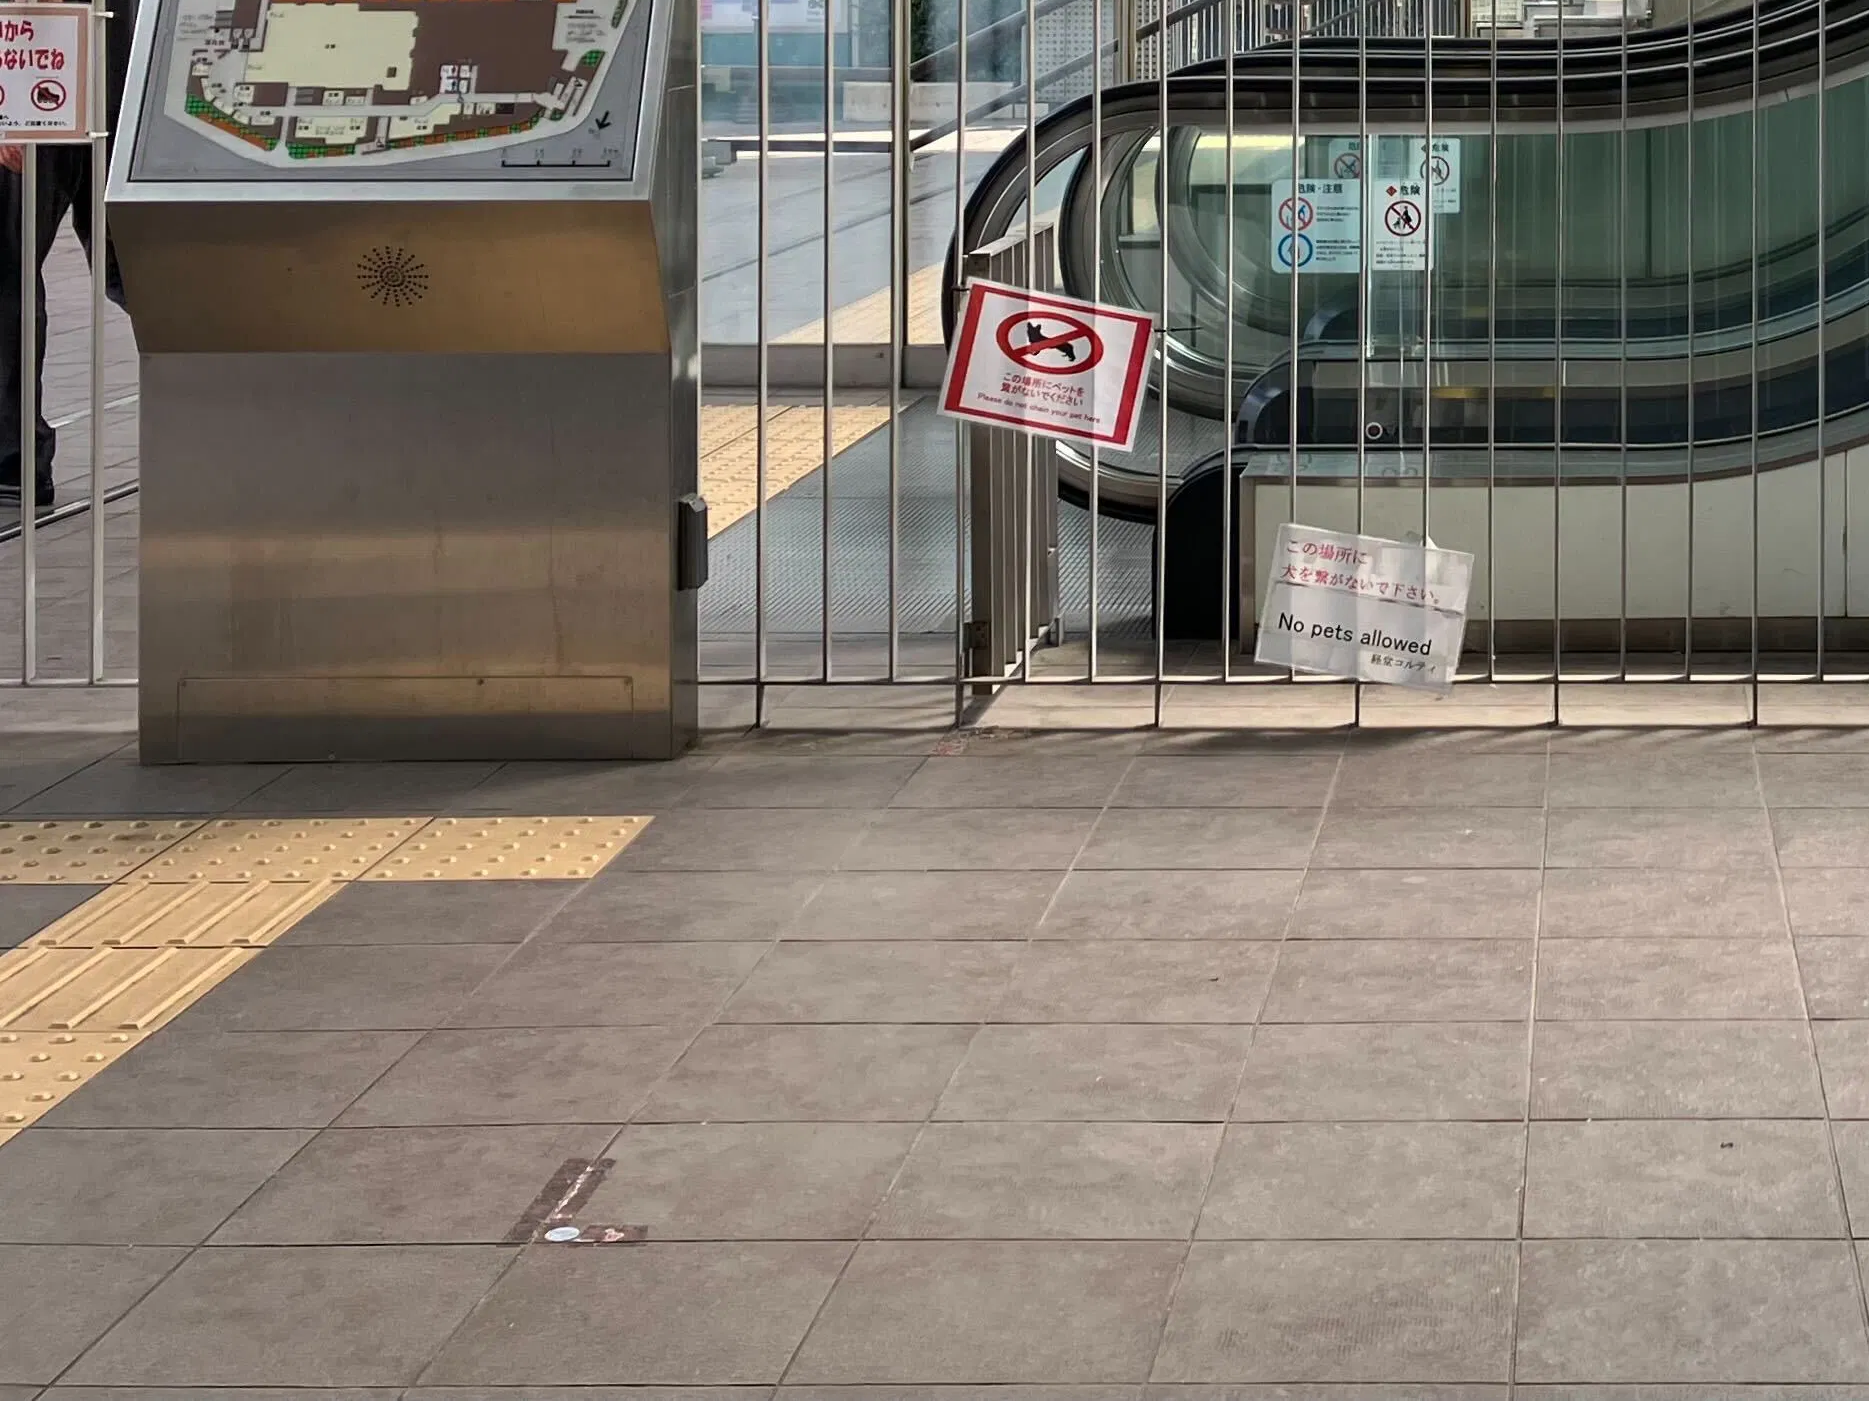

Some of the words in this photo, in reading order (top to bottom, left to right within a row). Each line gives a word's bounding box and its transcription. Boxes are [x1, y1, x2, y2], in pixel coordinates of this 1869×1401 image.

[0, 20, 34, 42] から
[0, 48, 65, 70] ないでね
[1400, 184, 1421, 196] 危険
[1003, 372, 1085, 397] この場所にペットを
[977, 392, 1002, 404] Please
[1004, 397, 1014, 406] do
[1015, 400, 1027, 409] not
[1029, 402, 1050, 414] chain
[1051, 409, 1067, 419] your
[1069, 412, 1083, 421] pet
[1084, 413, 1100, 424] here
[1286, 540, 1369, 566] この場所に
[1281, 564, 1440, 605] 犬を繋がないで下さい。
[1278, 612, 1305, 633] No
[1310, 623, 1353, 643] pets
[1360, 629, 1433, 656] allowed
